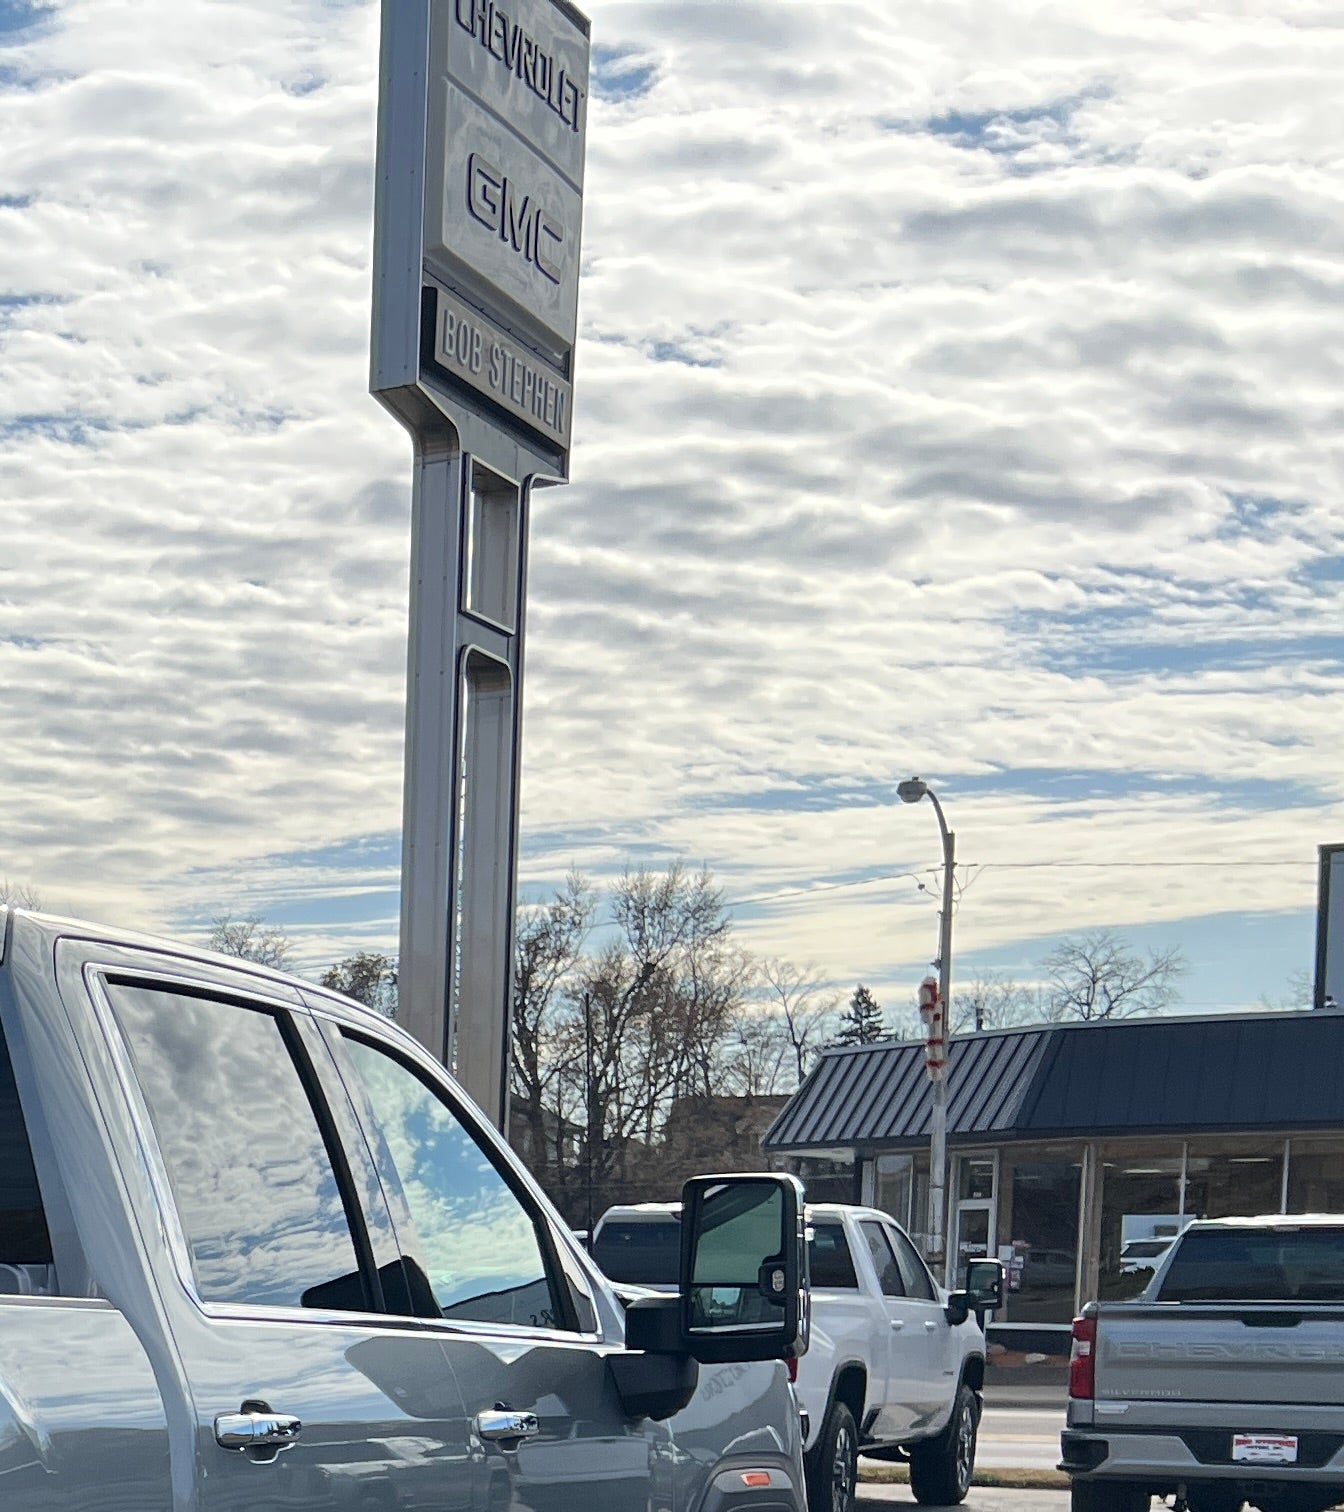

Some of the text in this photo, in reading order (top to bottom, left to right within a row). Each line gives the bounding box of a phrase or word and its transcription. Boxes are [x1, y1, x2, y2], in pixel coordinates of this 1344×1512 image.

[467, 152, 563, 285] GMC
[442, 308, 565, 434] BOB STEPHEN
